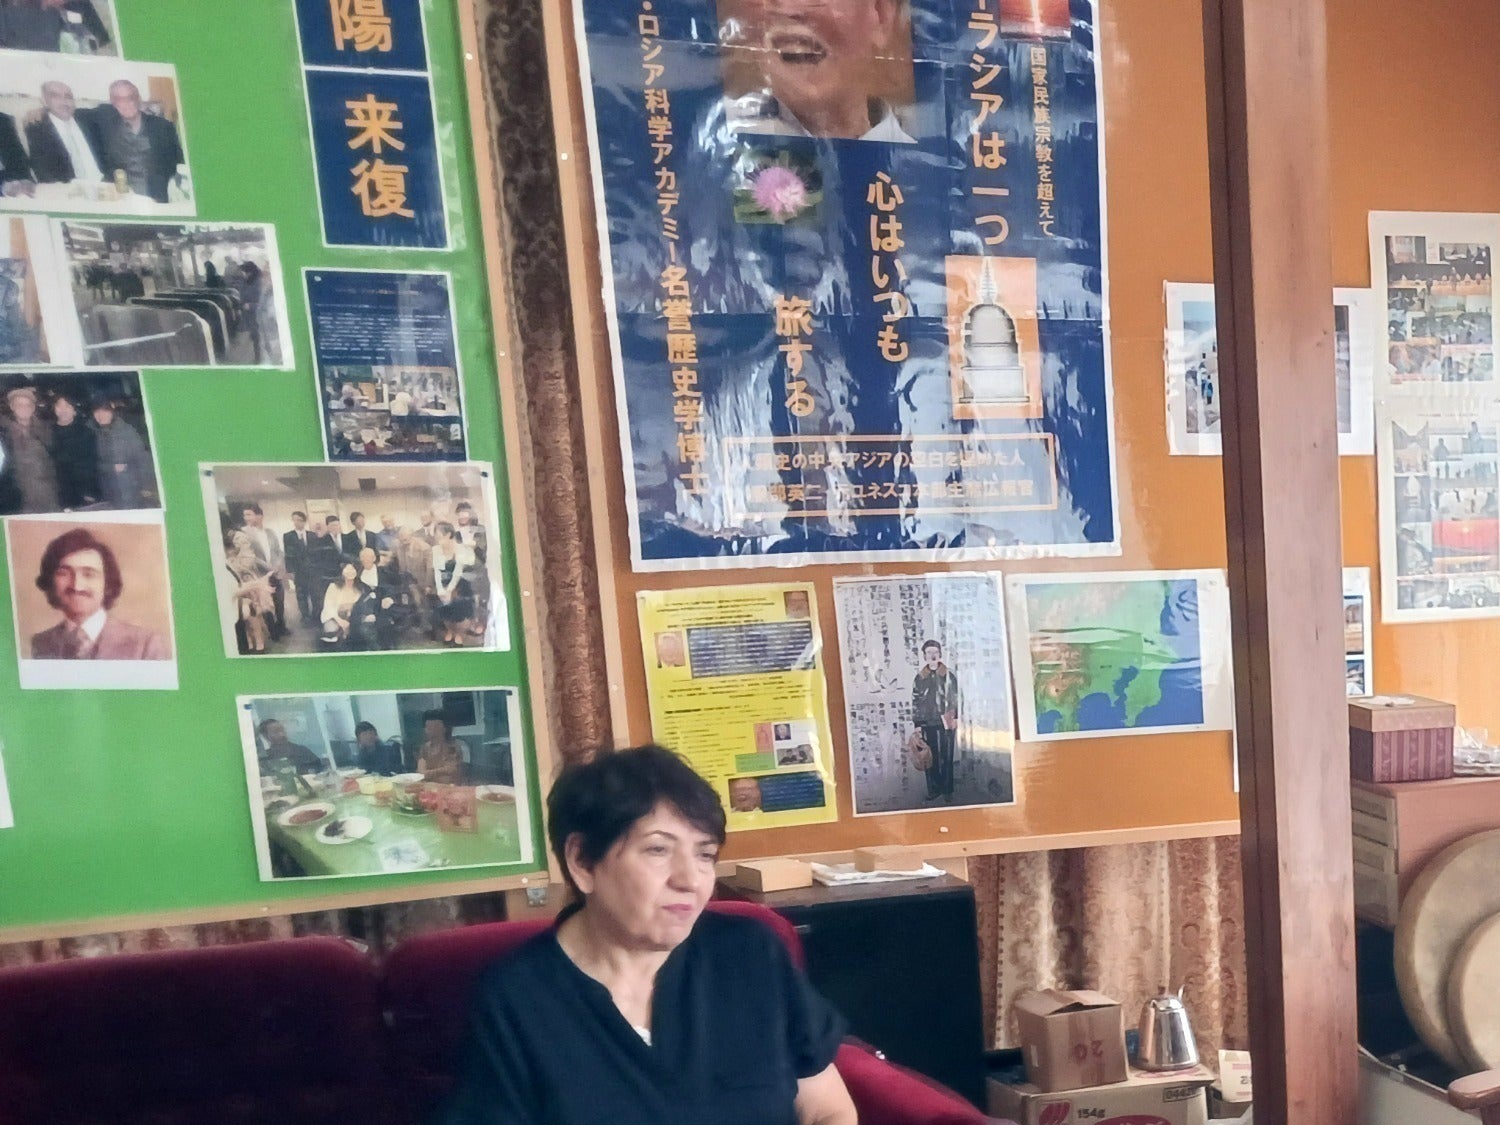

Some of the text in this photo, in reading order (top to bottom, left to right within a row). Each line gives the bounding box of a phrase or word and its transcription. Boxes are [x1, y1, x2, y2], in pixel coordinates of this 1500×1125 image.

[1030, 47, 1055, 237] 国家民族宗教を超えて
[775, 294, 816, 417] 旅する
[867, 171, 909, 363] 心はいつも
